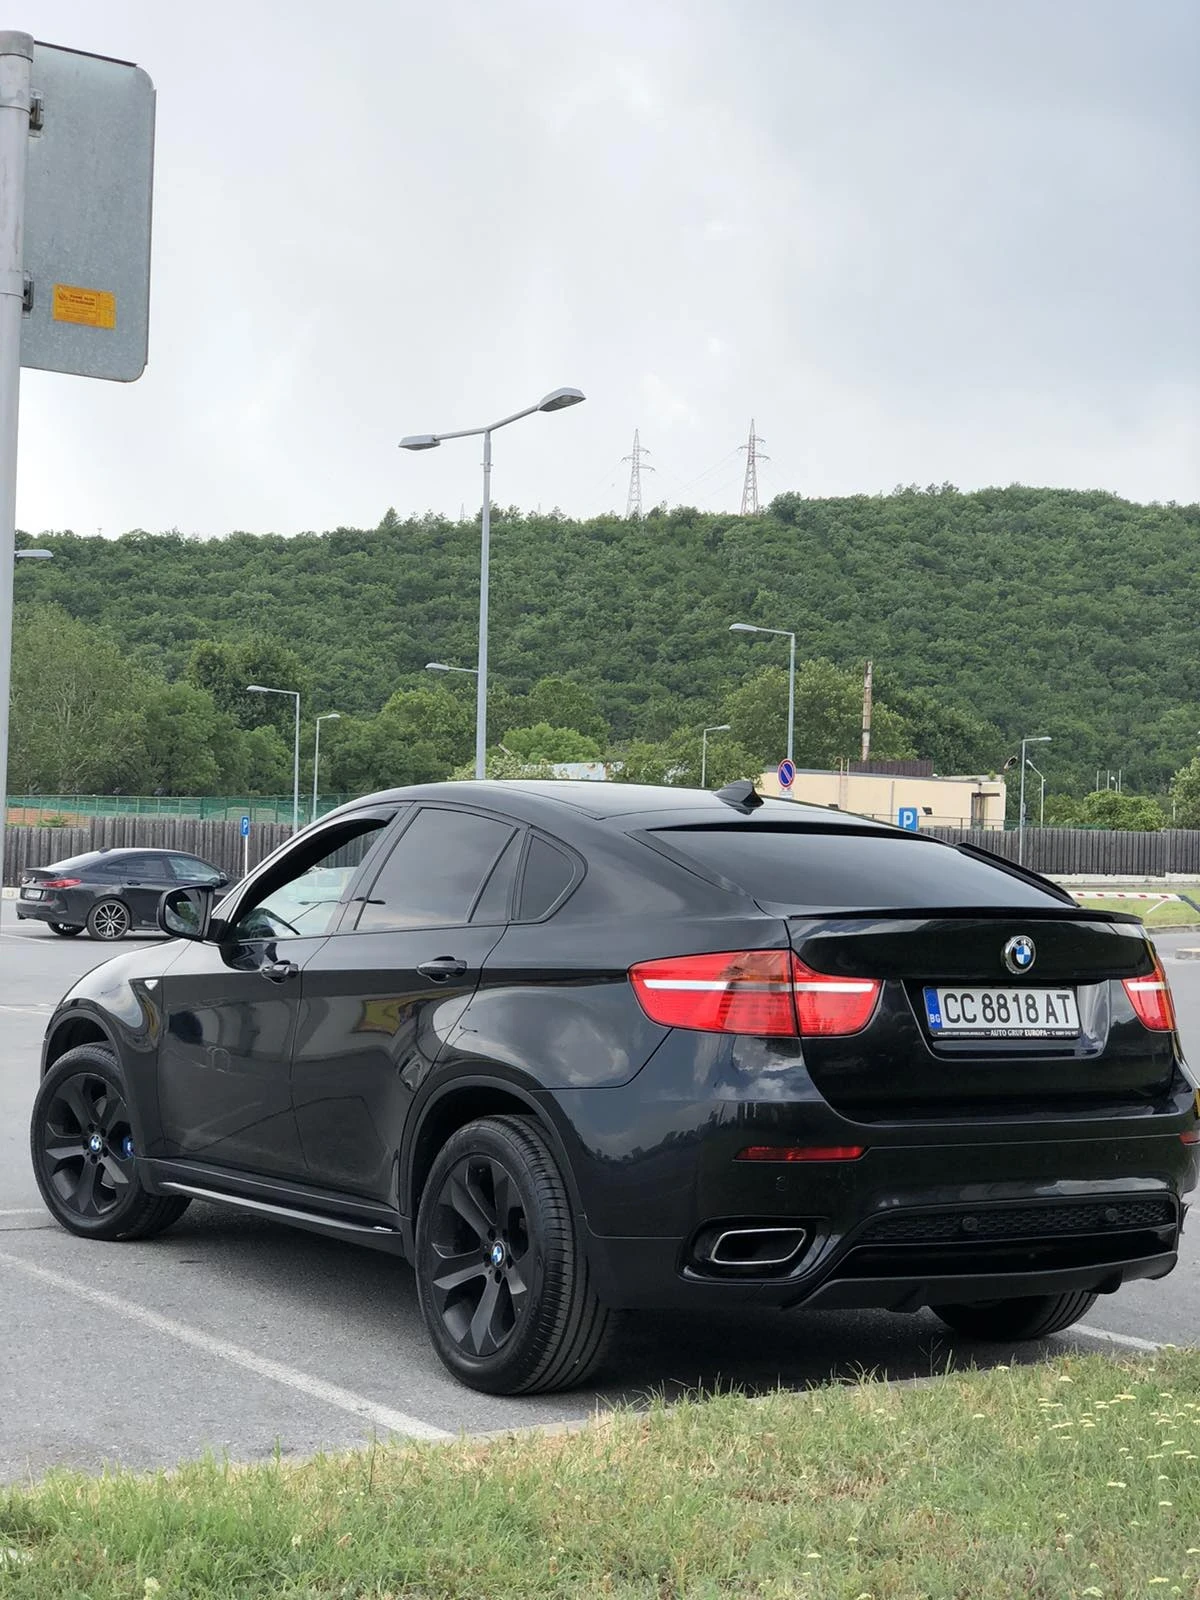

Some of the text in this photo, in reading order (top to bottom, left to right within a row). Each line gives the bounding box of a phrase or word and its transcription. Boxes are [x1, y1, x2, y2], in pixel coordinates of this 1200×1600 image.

[903, 811, 913, 828] P
[943, 993, 1071, 1024] CC 8818 AT
[929, 1013, 941, 1024] BG
